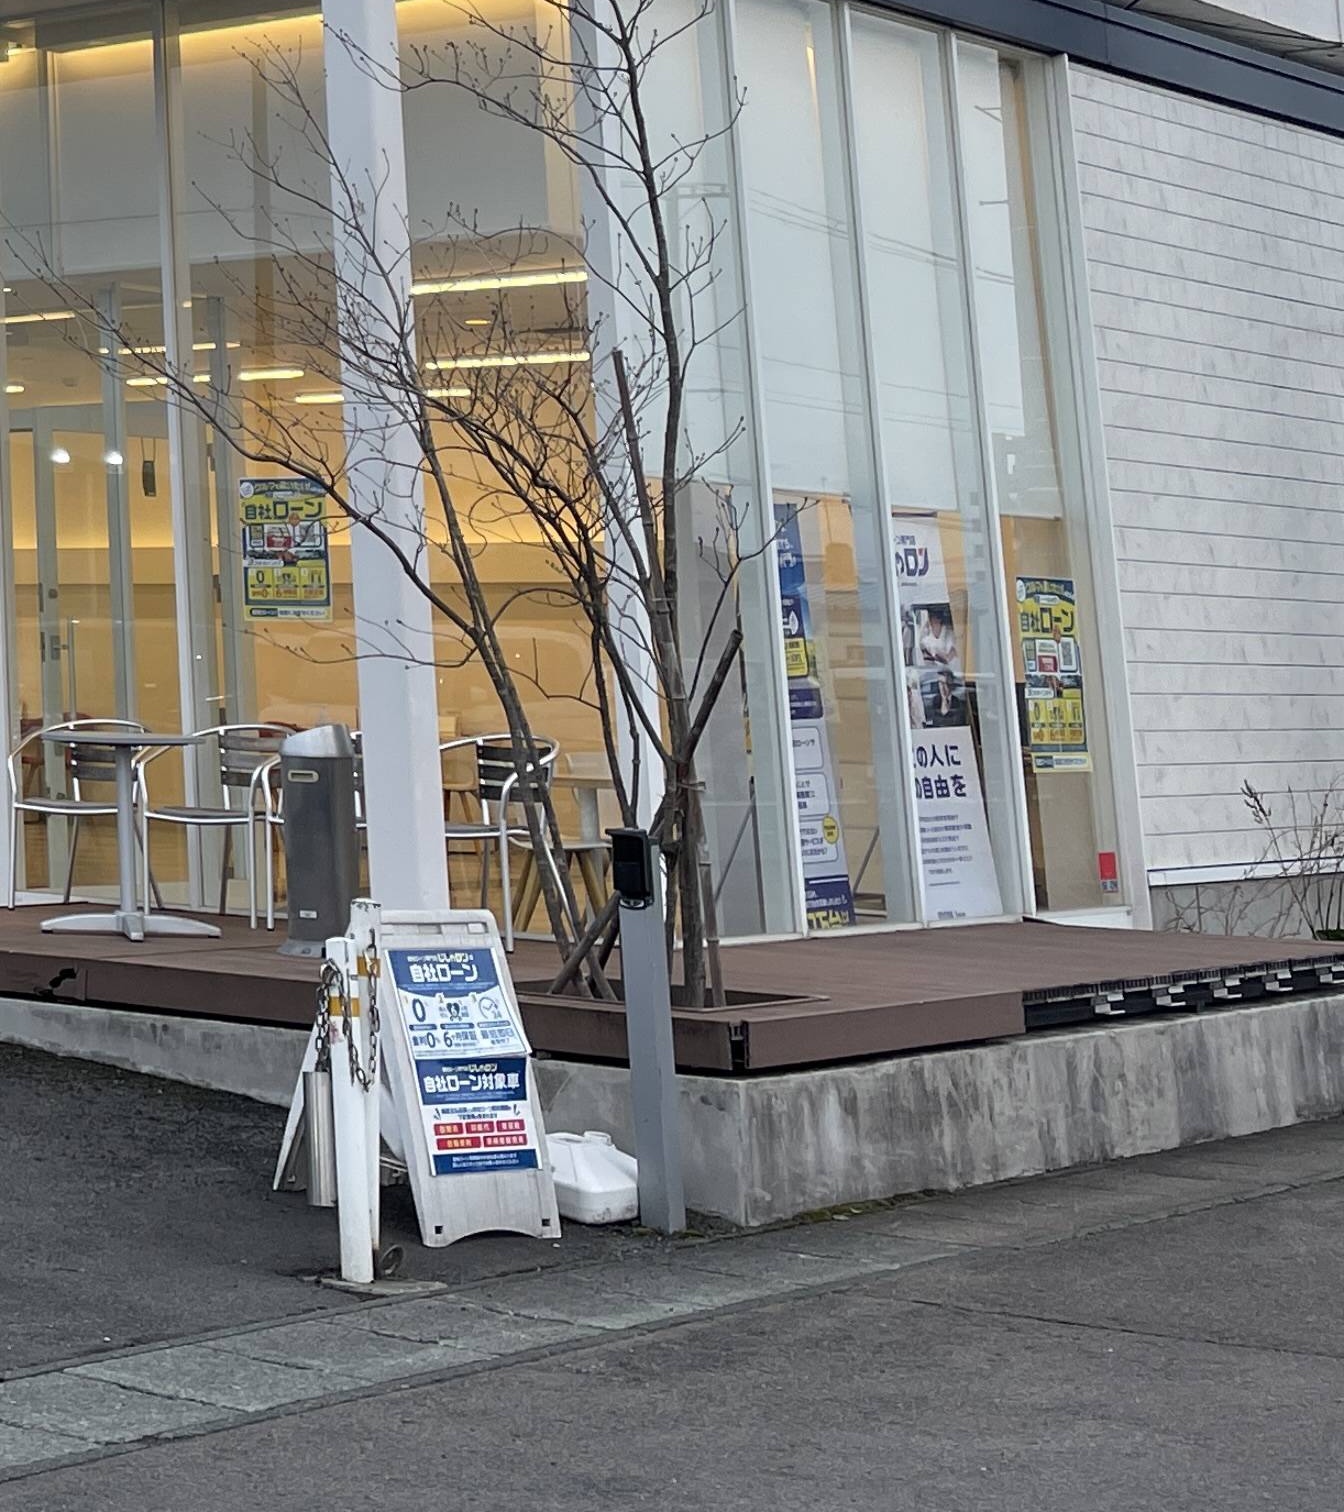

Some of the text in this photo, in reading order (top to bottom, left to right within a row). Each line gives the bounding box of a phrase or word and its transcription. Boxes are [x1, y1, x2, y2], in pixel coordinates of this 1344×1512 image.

[245, 500, 323, 520] 自社ローン
[913, 744, 962, 769] の人に
[409, 963, 479, 983] 自社ローン
[423, 1072, 520, 1094] 自社ローン対象車
